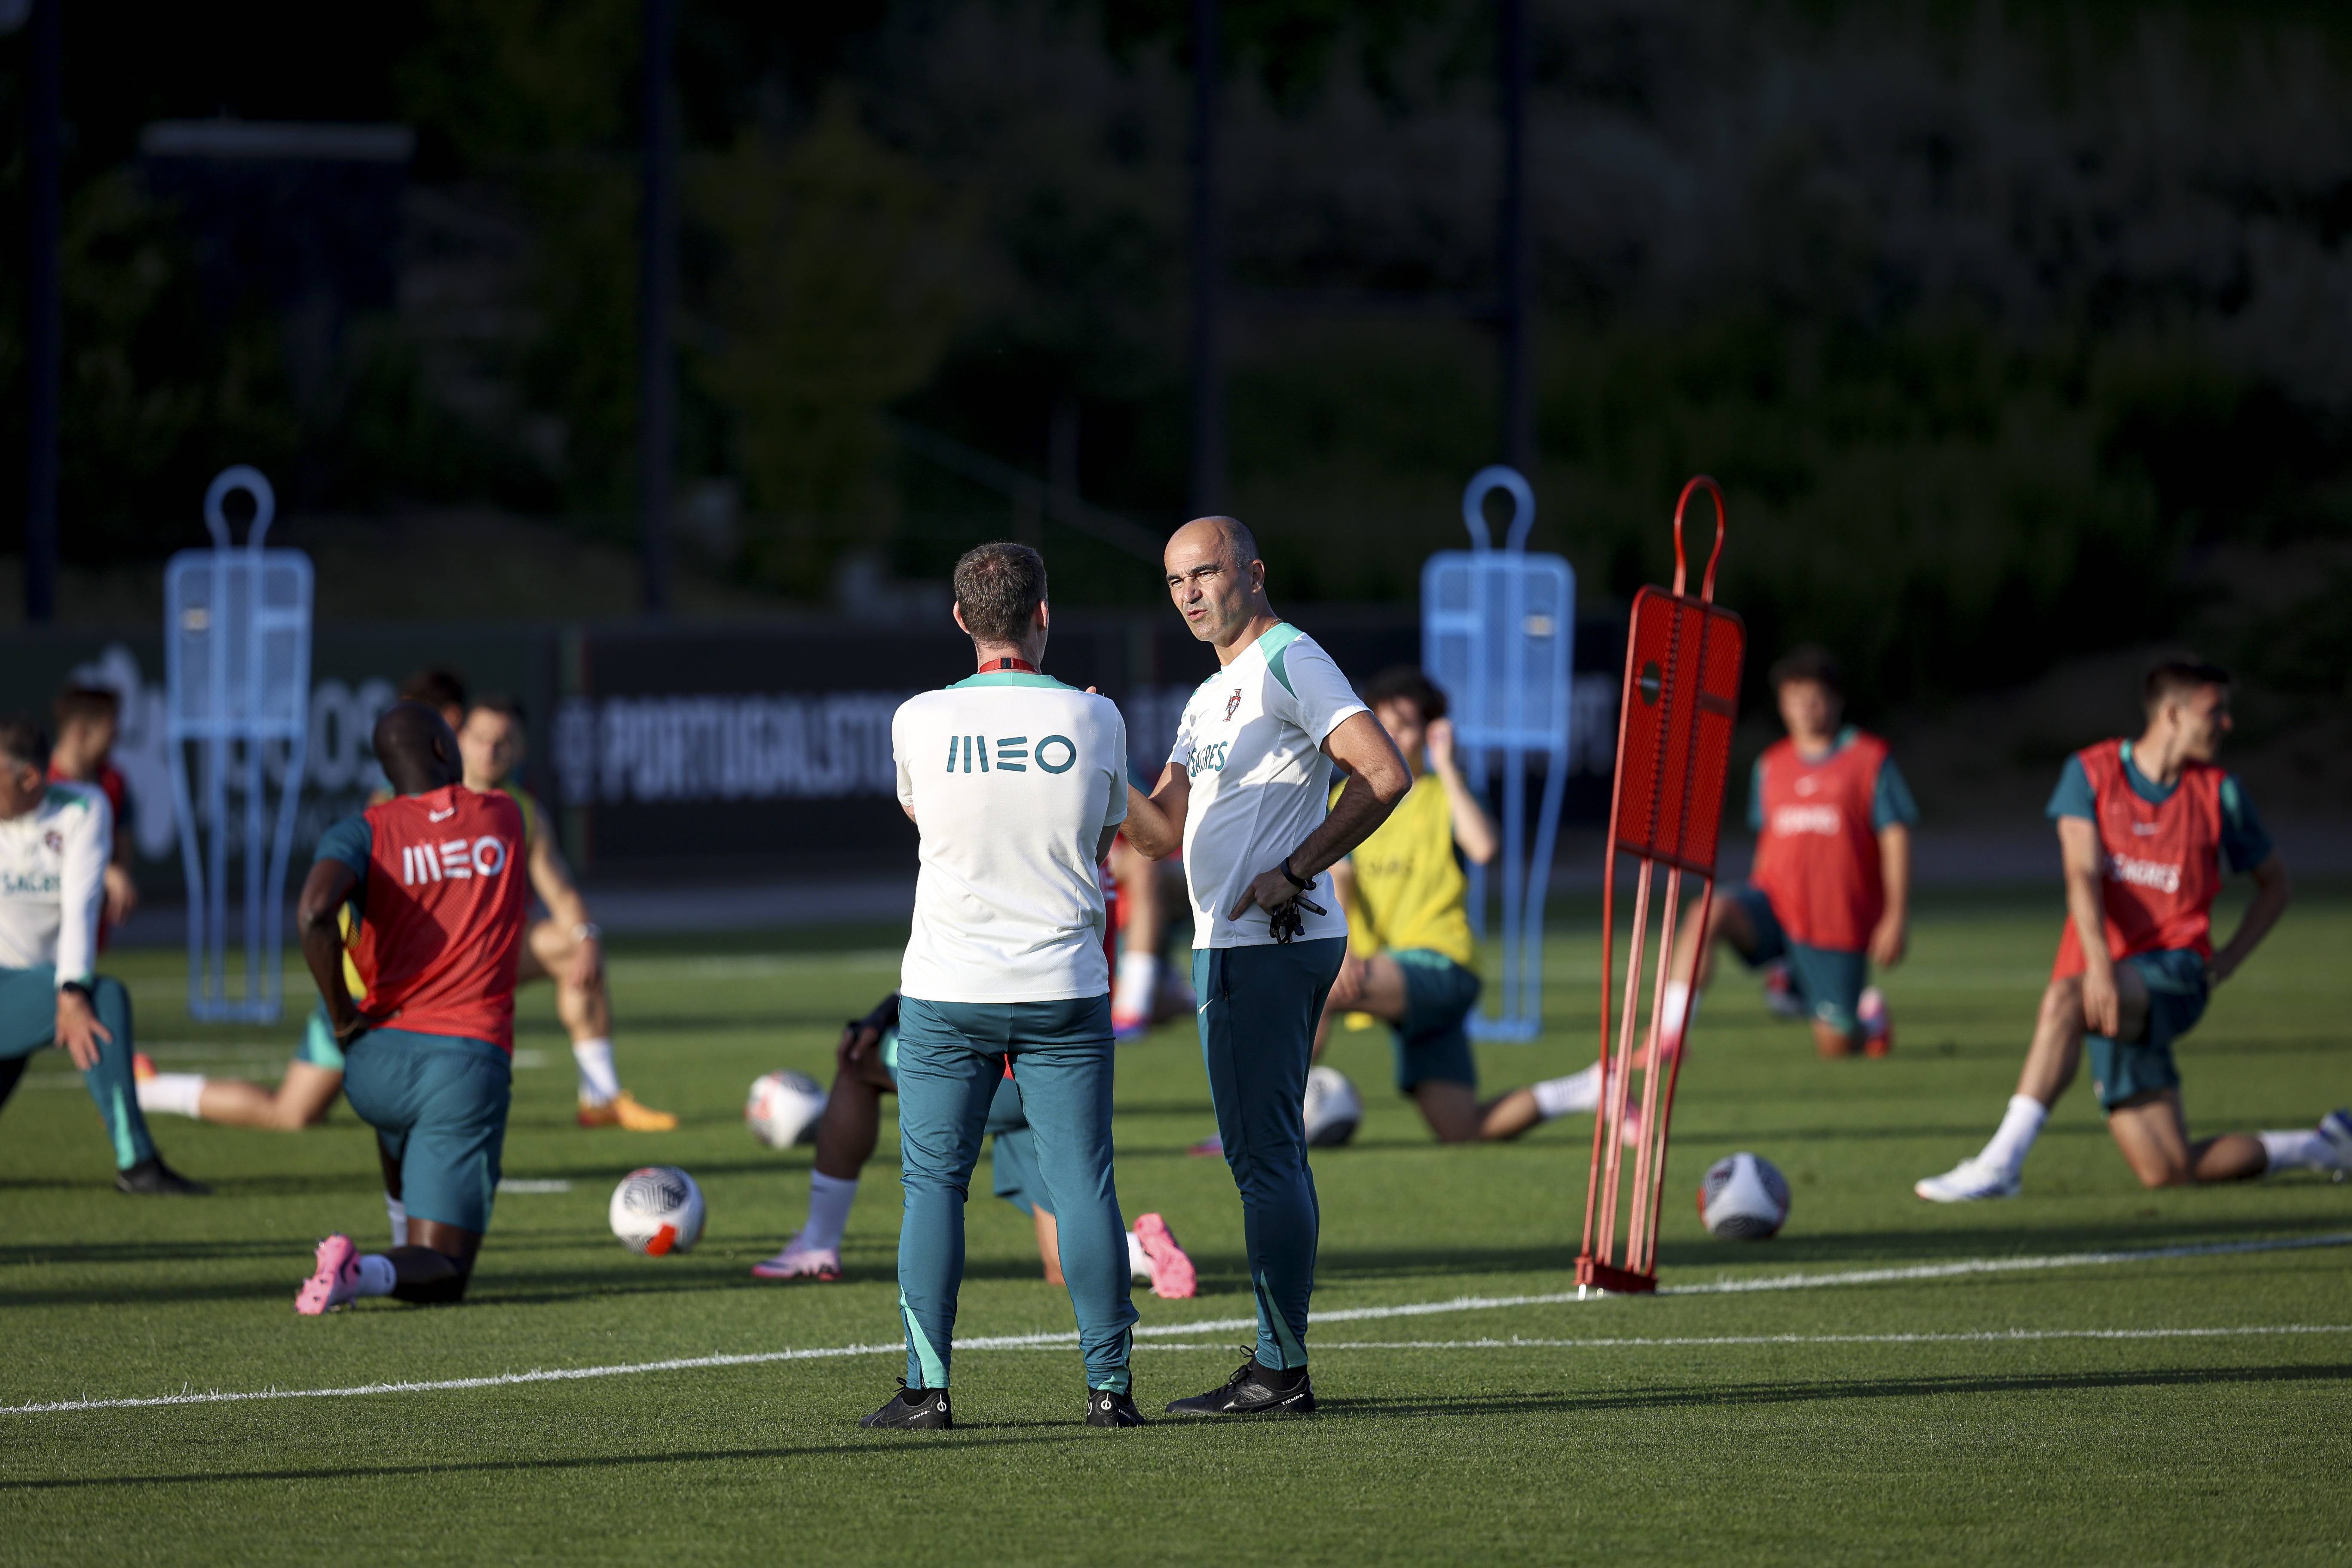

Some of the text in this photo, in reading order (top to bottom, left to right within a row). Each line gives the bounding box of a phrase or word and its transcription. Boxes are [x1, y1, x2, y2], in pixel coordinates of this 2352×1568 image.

[946, 735, 1077, 774] MEO
[1190, 741, 1228, 777] SAGRES
[403, 835, 506, 886] MEO
[909, 1411, 930, 1421] TIEMPO
[1281, 1394, 1305, 1405] TIEMPO
